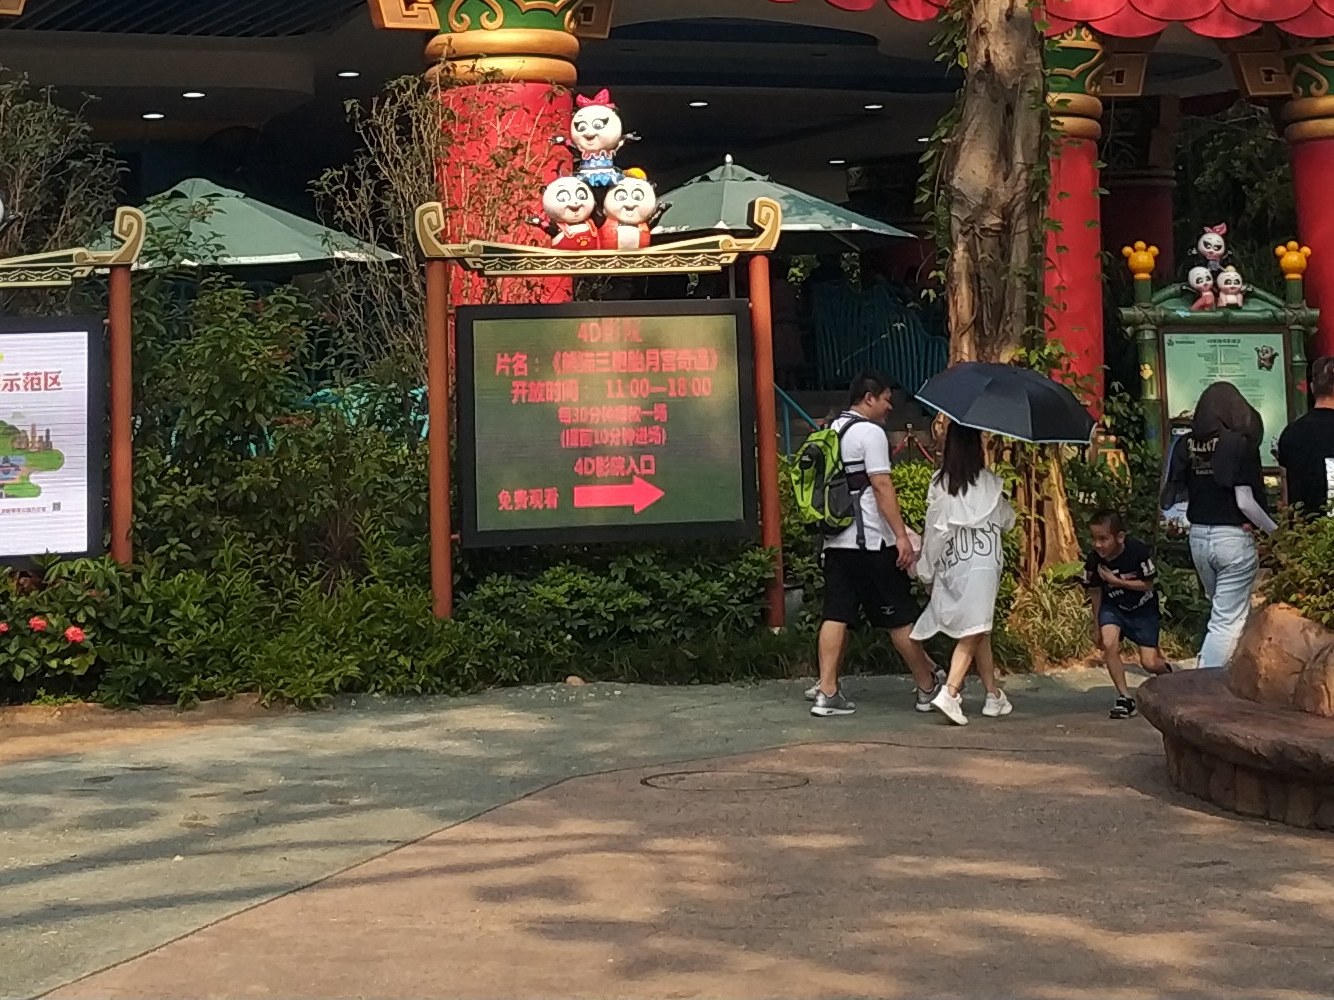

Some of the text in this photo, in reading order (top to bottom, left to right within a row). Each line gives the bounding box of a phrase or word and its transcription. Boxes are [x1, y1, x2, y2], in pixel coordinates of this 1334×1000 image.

[574, 455, 656, 477] 4D影院入口
[497, 487, 559, 511] 免费观看
